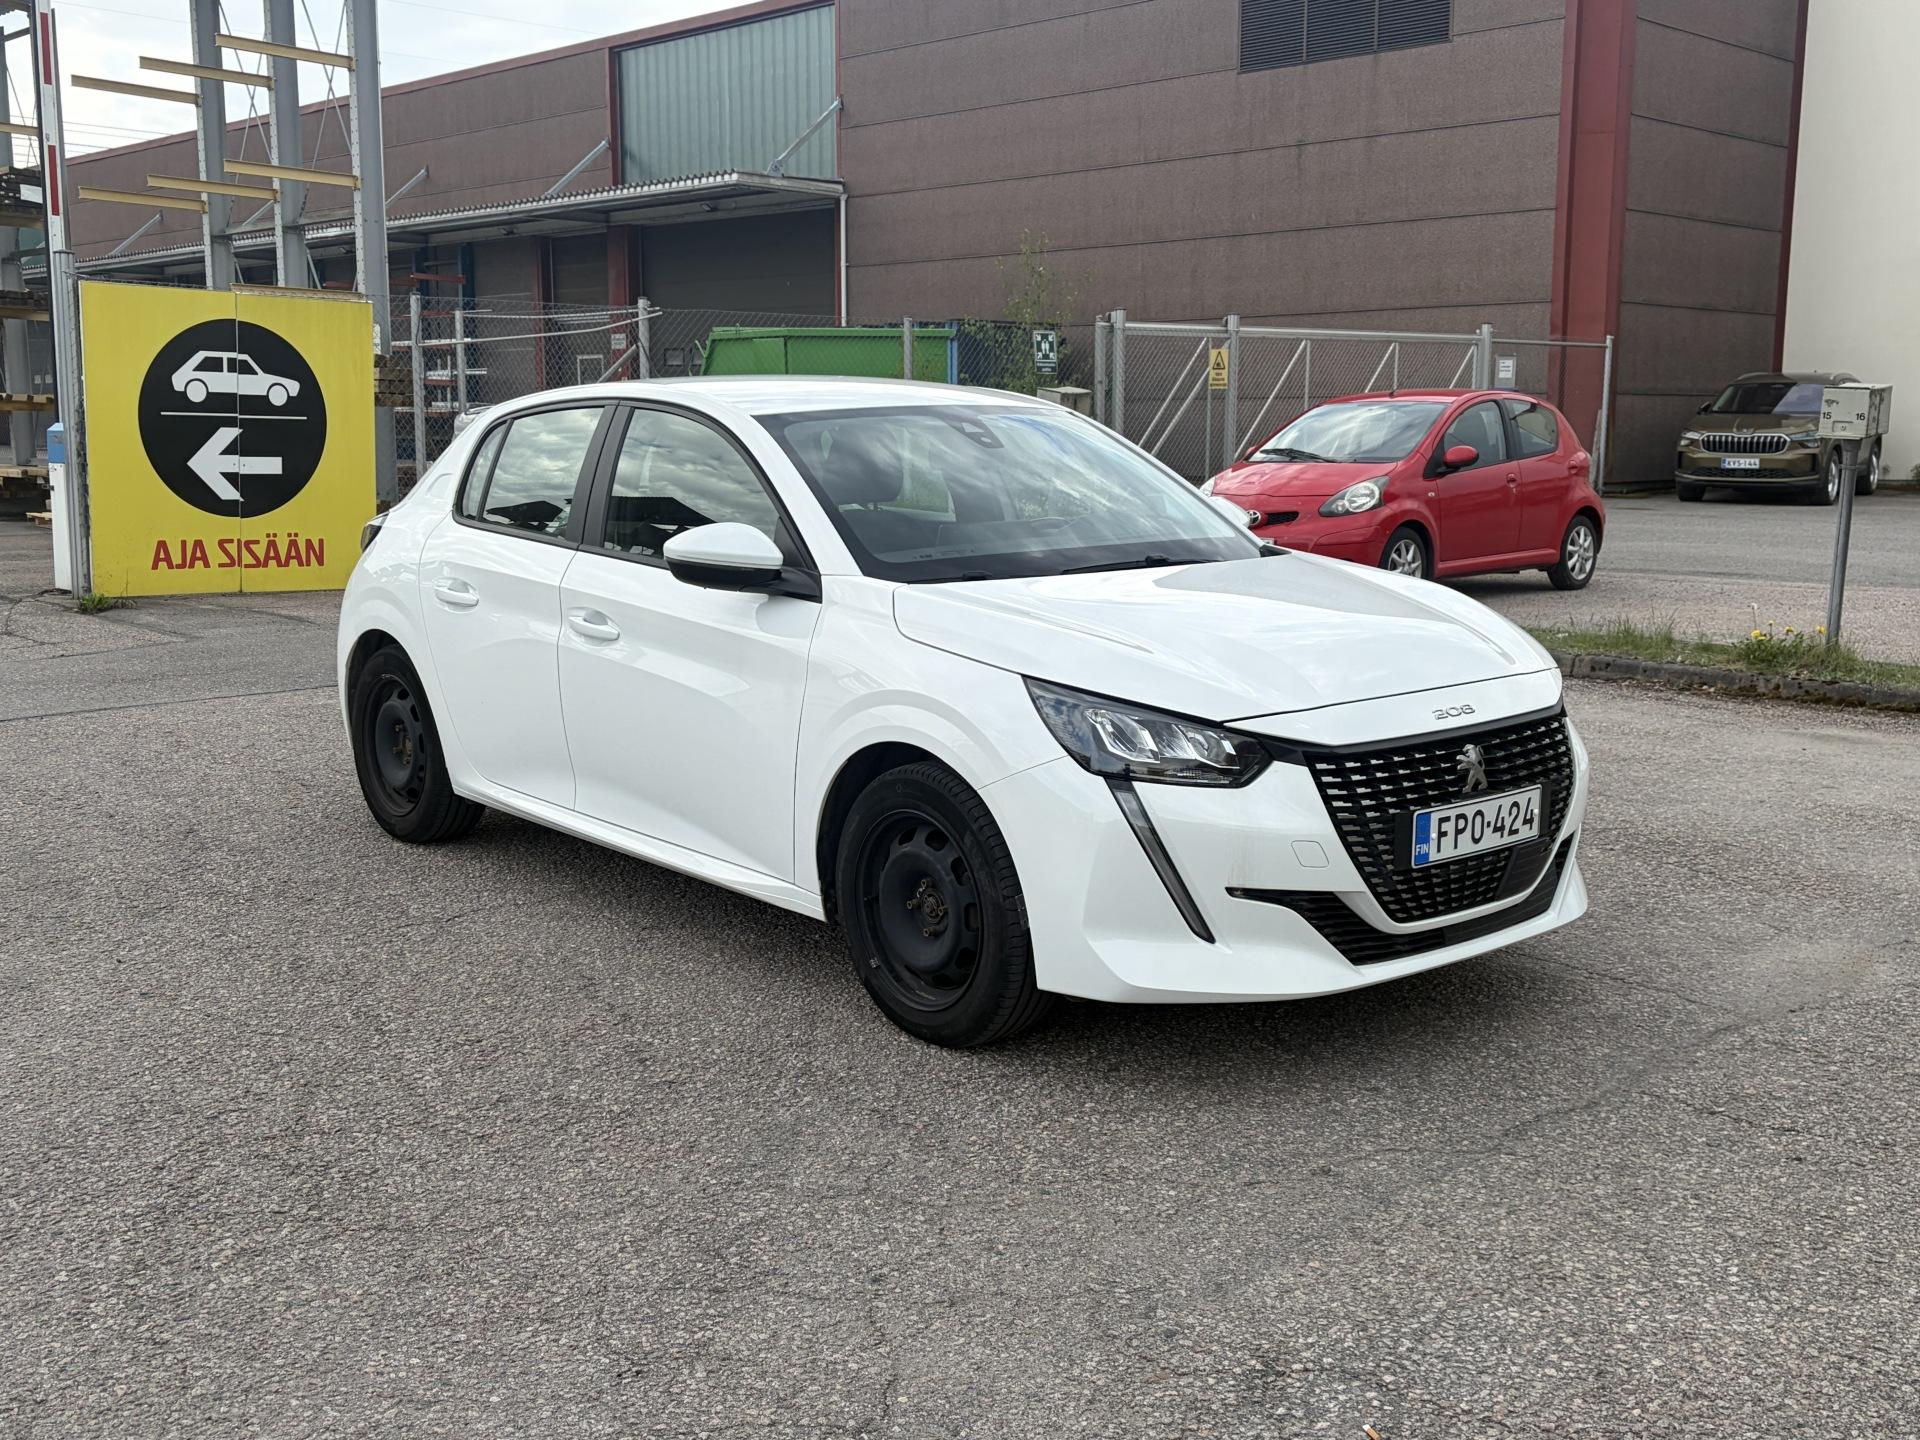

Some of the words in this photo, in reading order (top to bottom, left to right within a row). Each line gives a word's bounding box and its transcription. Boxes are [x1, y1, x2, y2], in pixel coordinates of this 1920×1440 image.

[1822, 412, 1832, 420] 15
[1856, 412, 1866, 421] 16
[151, 539, 211, 570] AJA
[217, 532, 325, 569] SISÄÄN
[1432, 704, 1476, 720] 208
[1436, 797, 1535, 854] FPO-424
[1415, 842, 1429, 856] FIN
